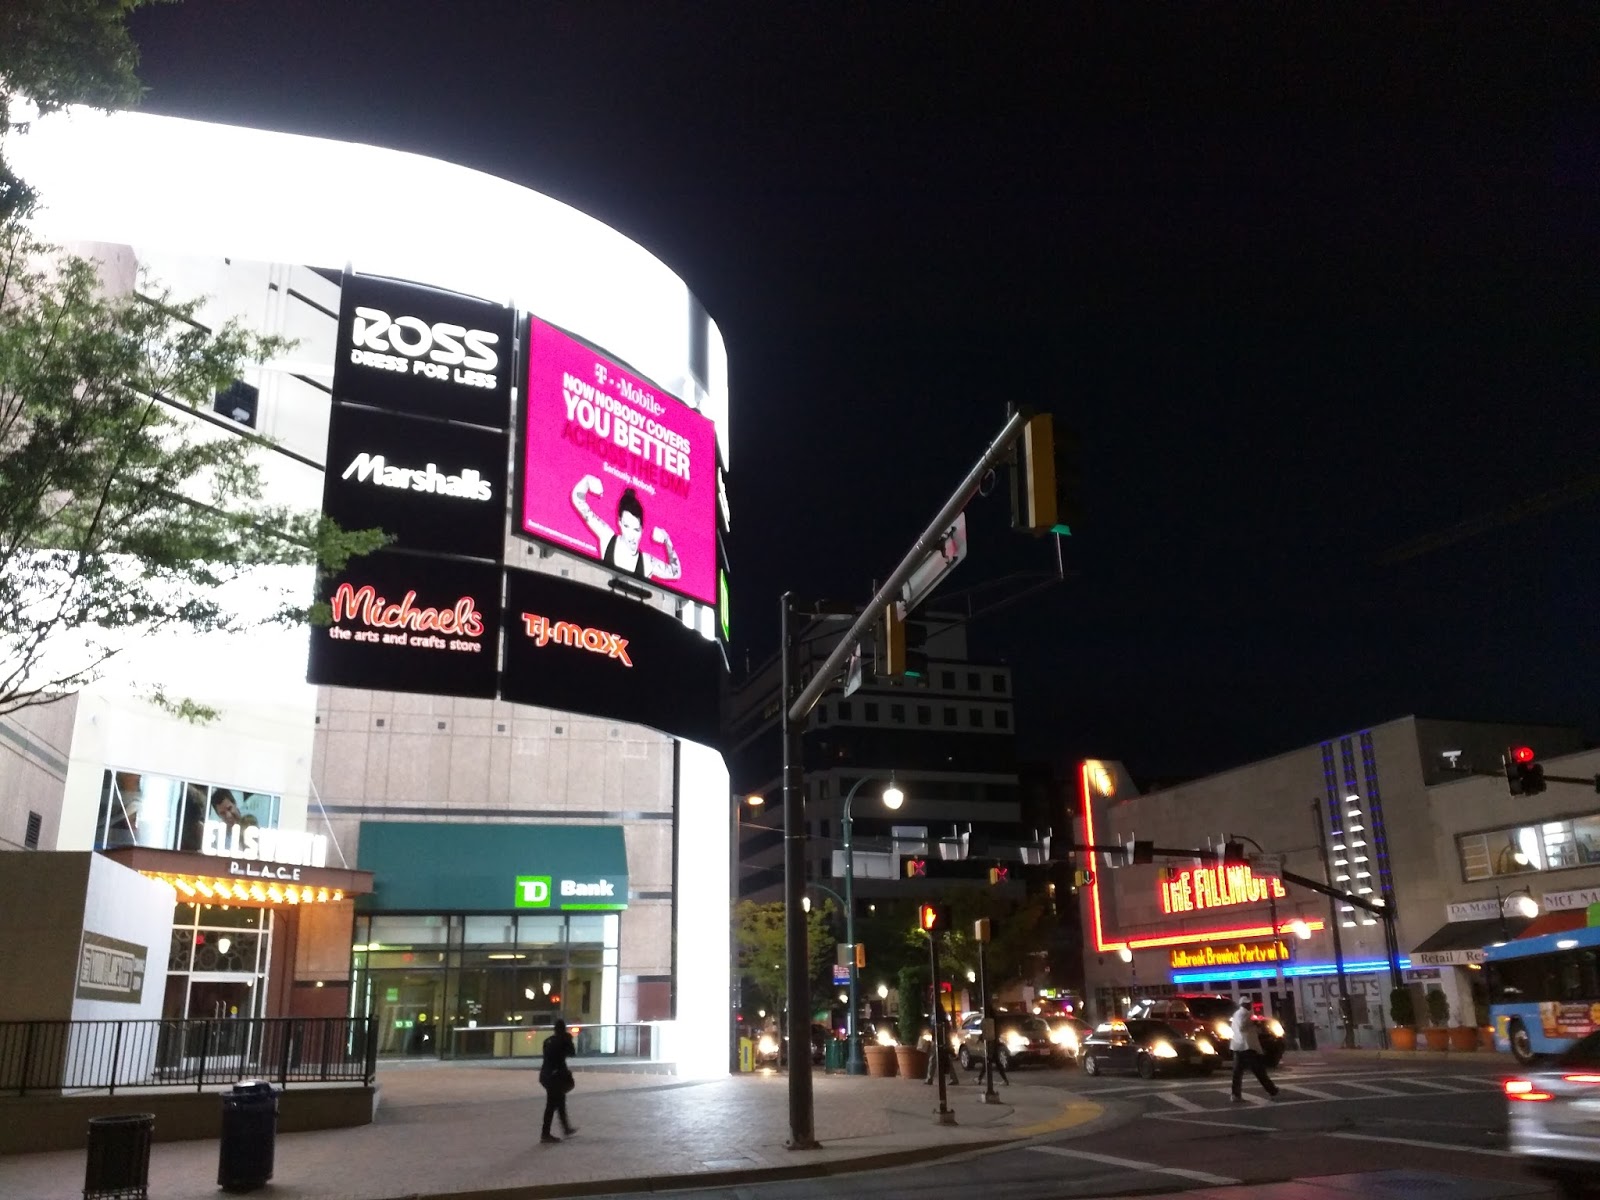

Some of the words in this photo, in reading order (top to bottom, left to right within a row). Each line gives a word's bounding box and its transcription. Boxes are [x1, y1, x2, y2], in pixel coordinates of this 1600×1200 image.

[352, 306, 500, 371] ROSS
[350, 349, 409, 373] DRESS
[413, 360, 450, 381] FOR
[453, 368, 498, 390] LESS
[563, 371, 595, 402] NOW
[595, 389, 646, 429] NOBODY
[646, 419, 691, 455] COVERS
[563, 388, 611, 438] YOU
[613, 416, 691, 480] BETTER
[562, 421, 628, 469] ACROSS
[631, 453, 659, 485] THE
[341, 452, 493, 501] Marshalls
[330, 582, 485, 637] Michaels
[329, 625, 351, 640] the
[354, 629, 380, 643] arts
[382, 632, 407, 646] and
[409, 635, 446, 649] crafts
[449, 639, 482, 653] store
[201, 819, 328, 868] ELLSWTH
[230, 861, 301, 881] PLACE
[519, 881, 548, 902] TD
[560, 879, 615, 897] Bank
[1240, 943, 1266, 963] Party
[1267, 941, 1290, 961] wih
[1420, 951, 1454, 964] Retail
[1308, 979, 1380, 998] TICETS
